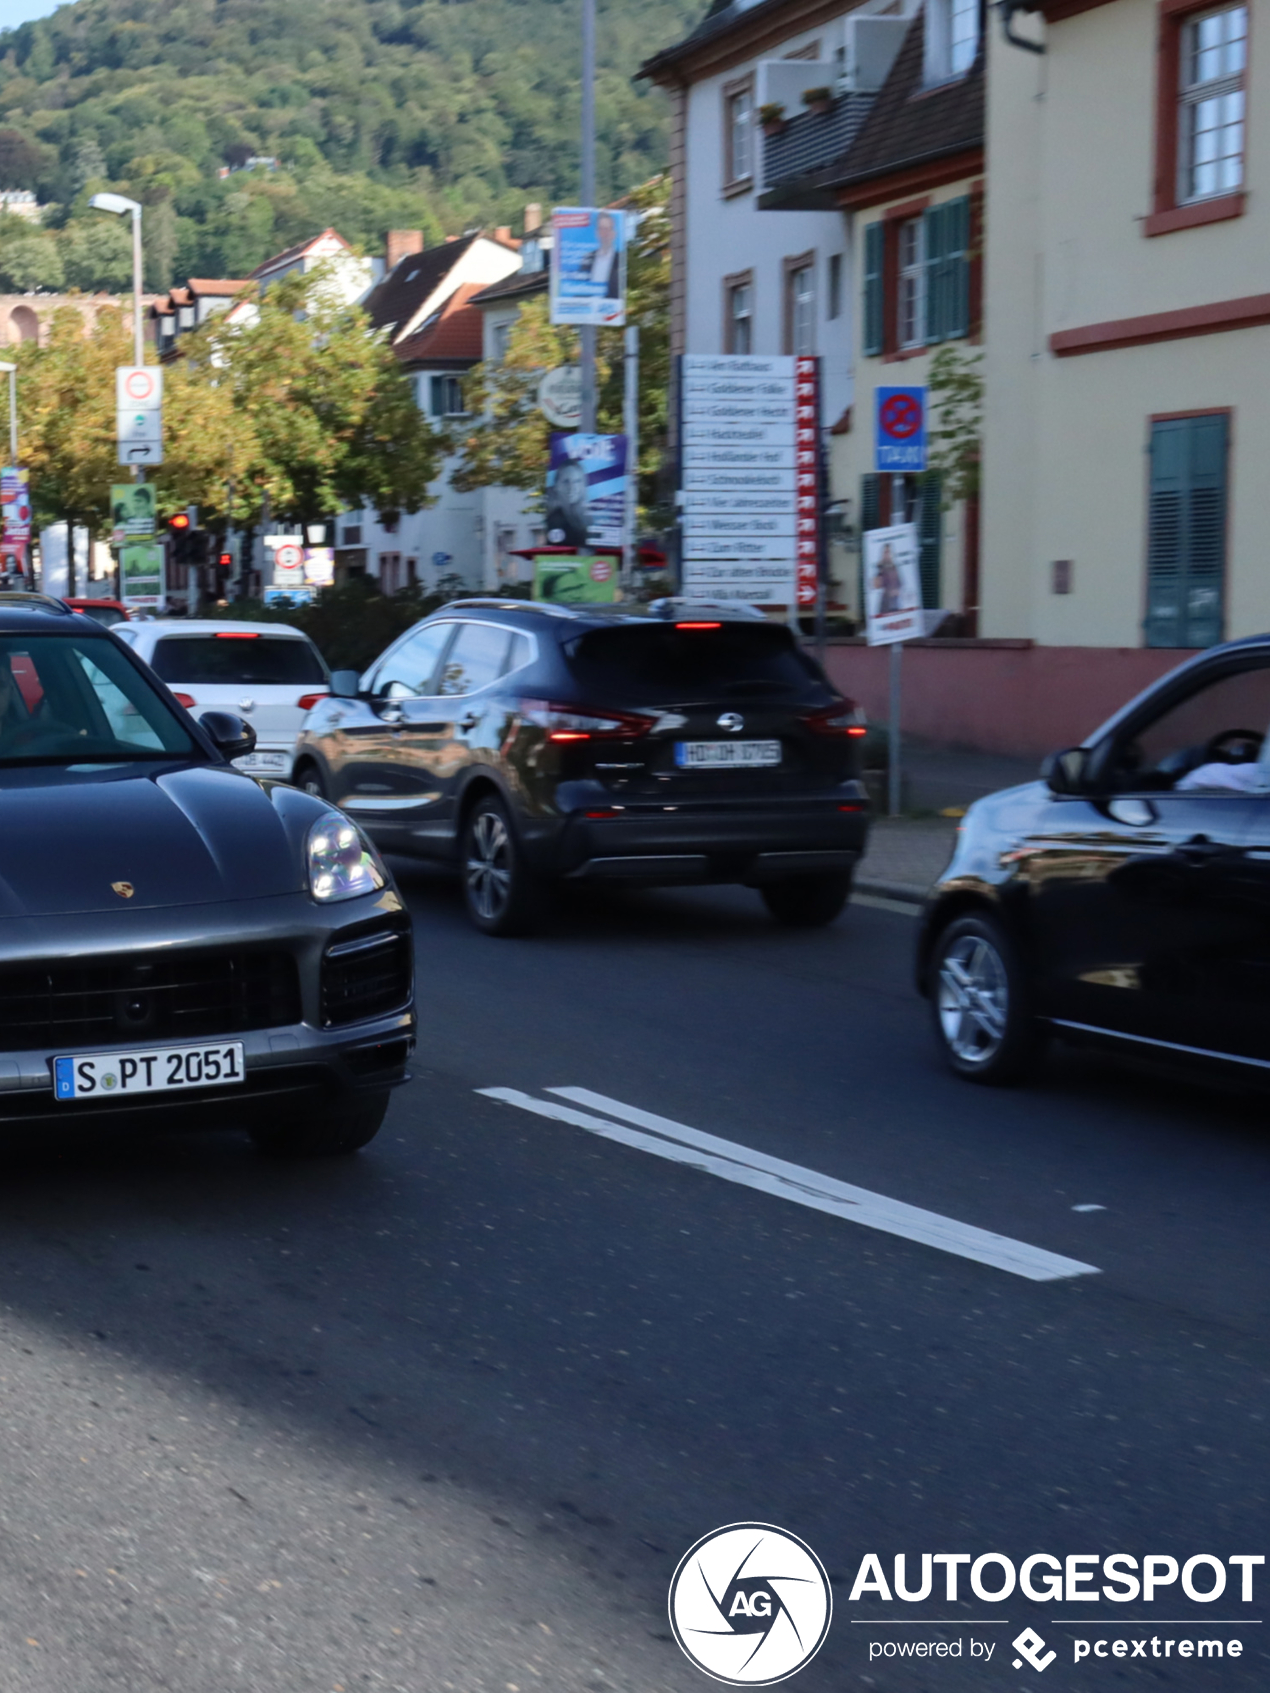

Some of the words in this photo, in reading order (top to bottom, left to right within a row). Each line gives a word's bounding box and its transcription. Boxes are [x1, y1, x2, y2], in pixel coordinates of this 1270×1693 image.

[61, 1081, 70, 1092] D
[77, 1061, 96, 1093] S
[118, 1056, 158, 1089] PT
[166, 1047, 240, 1085] 2051
